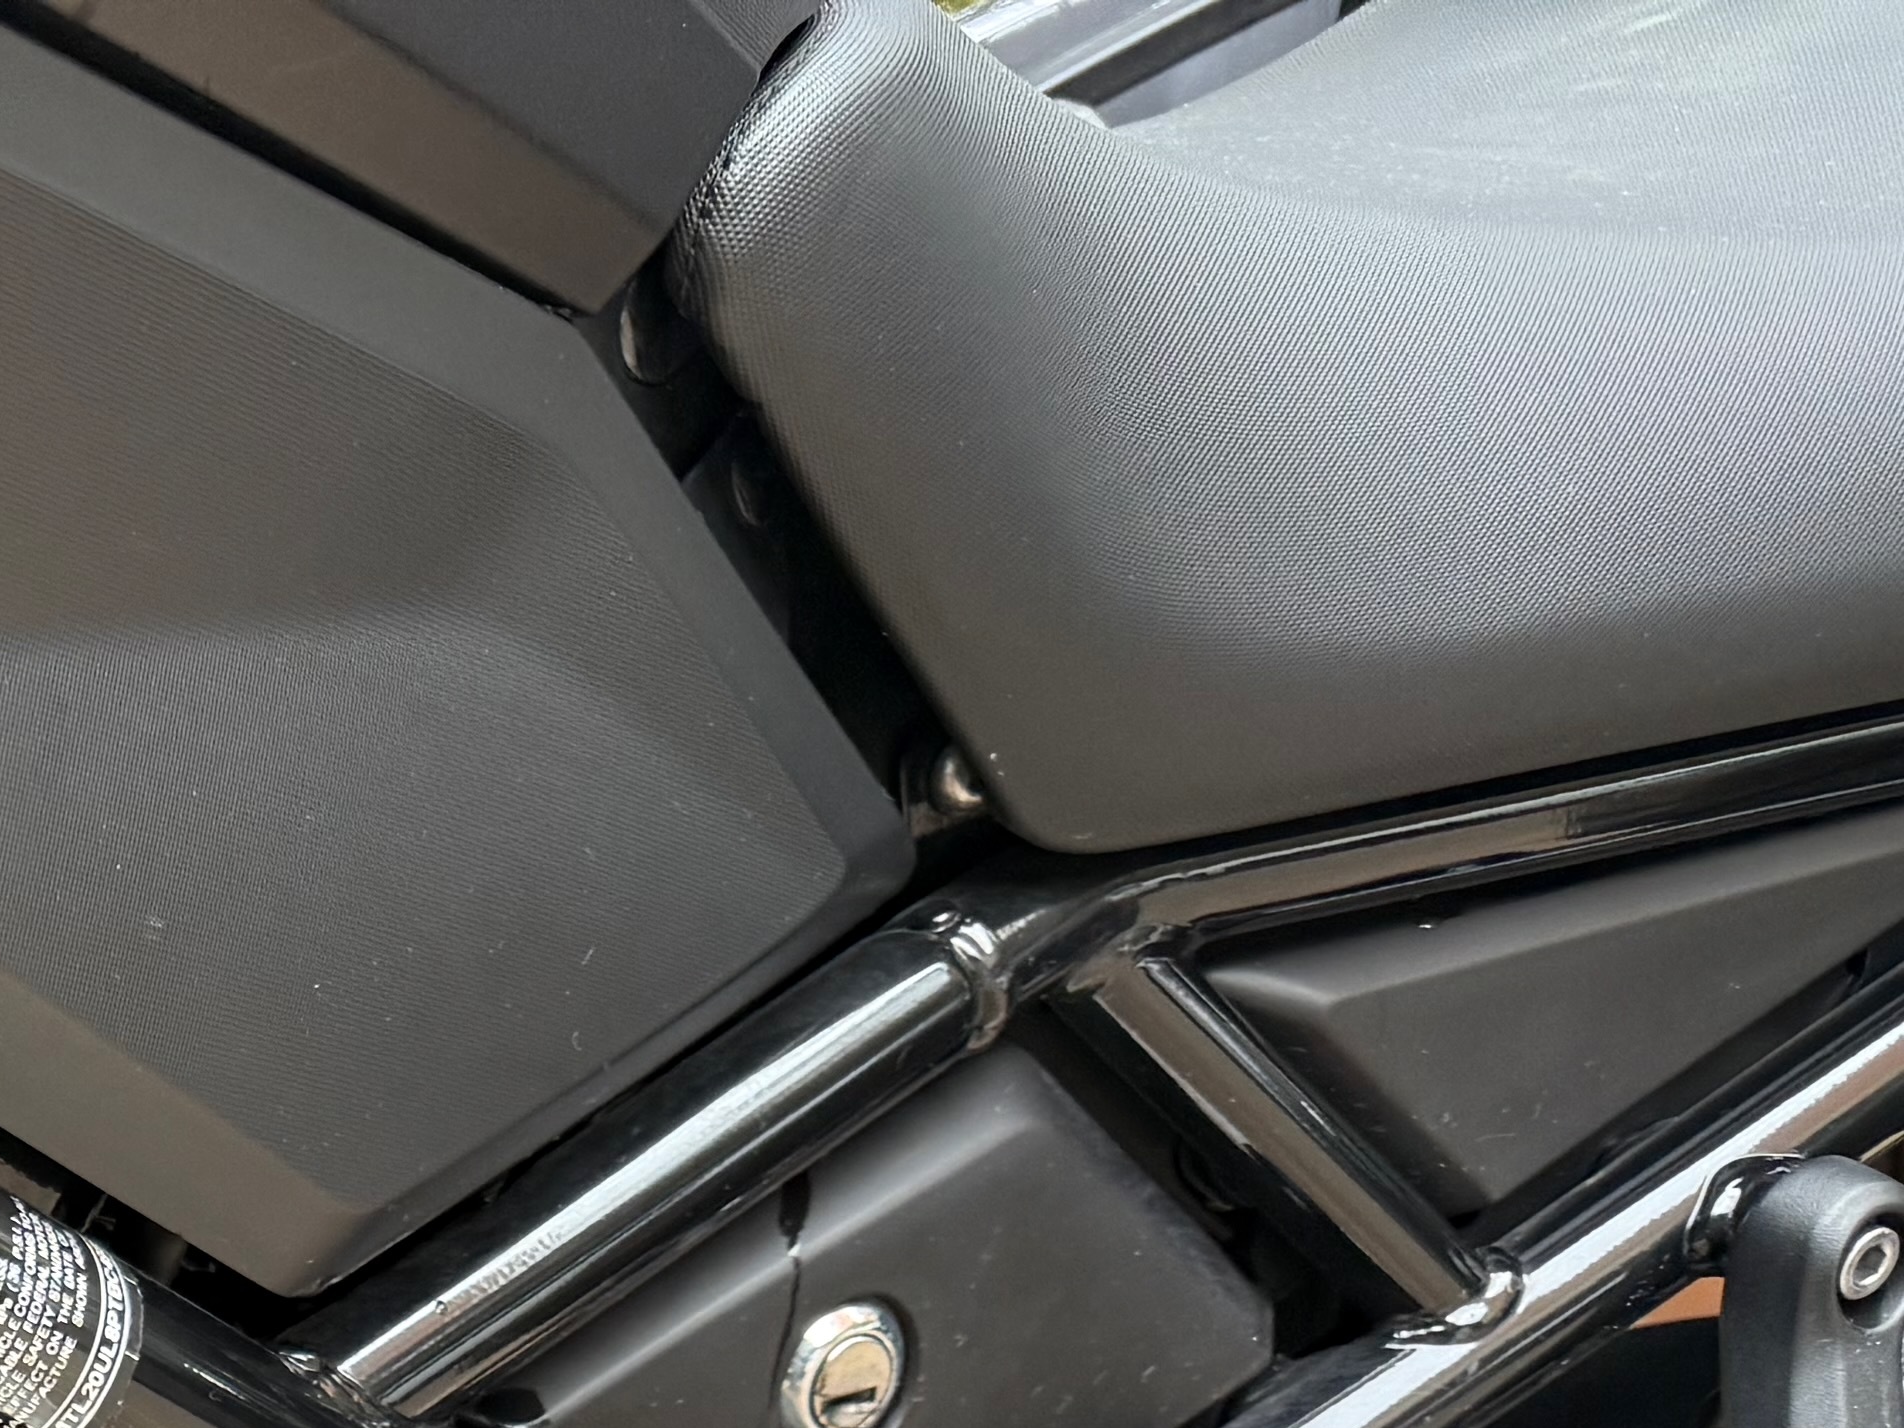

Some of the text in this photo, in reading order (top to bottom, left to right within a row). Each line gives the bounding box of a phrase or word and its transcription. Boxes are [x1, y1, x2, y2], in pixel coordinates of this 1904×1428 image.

[22, 1265, 50, 1333] FEDERAL
[45, 1329, 63, 1355] ON
[56, 1291, 74, 1323] THE
[71, 1272, 87, 1327] SHOWN
[22, 1303, 56, 1366] SAFETY
